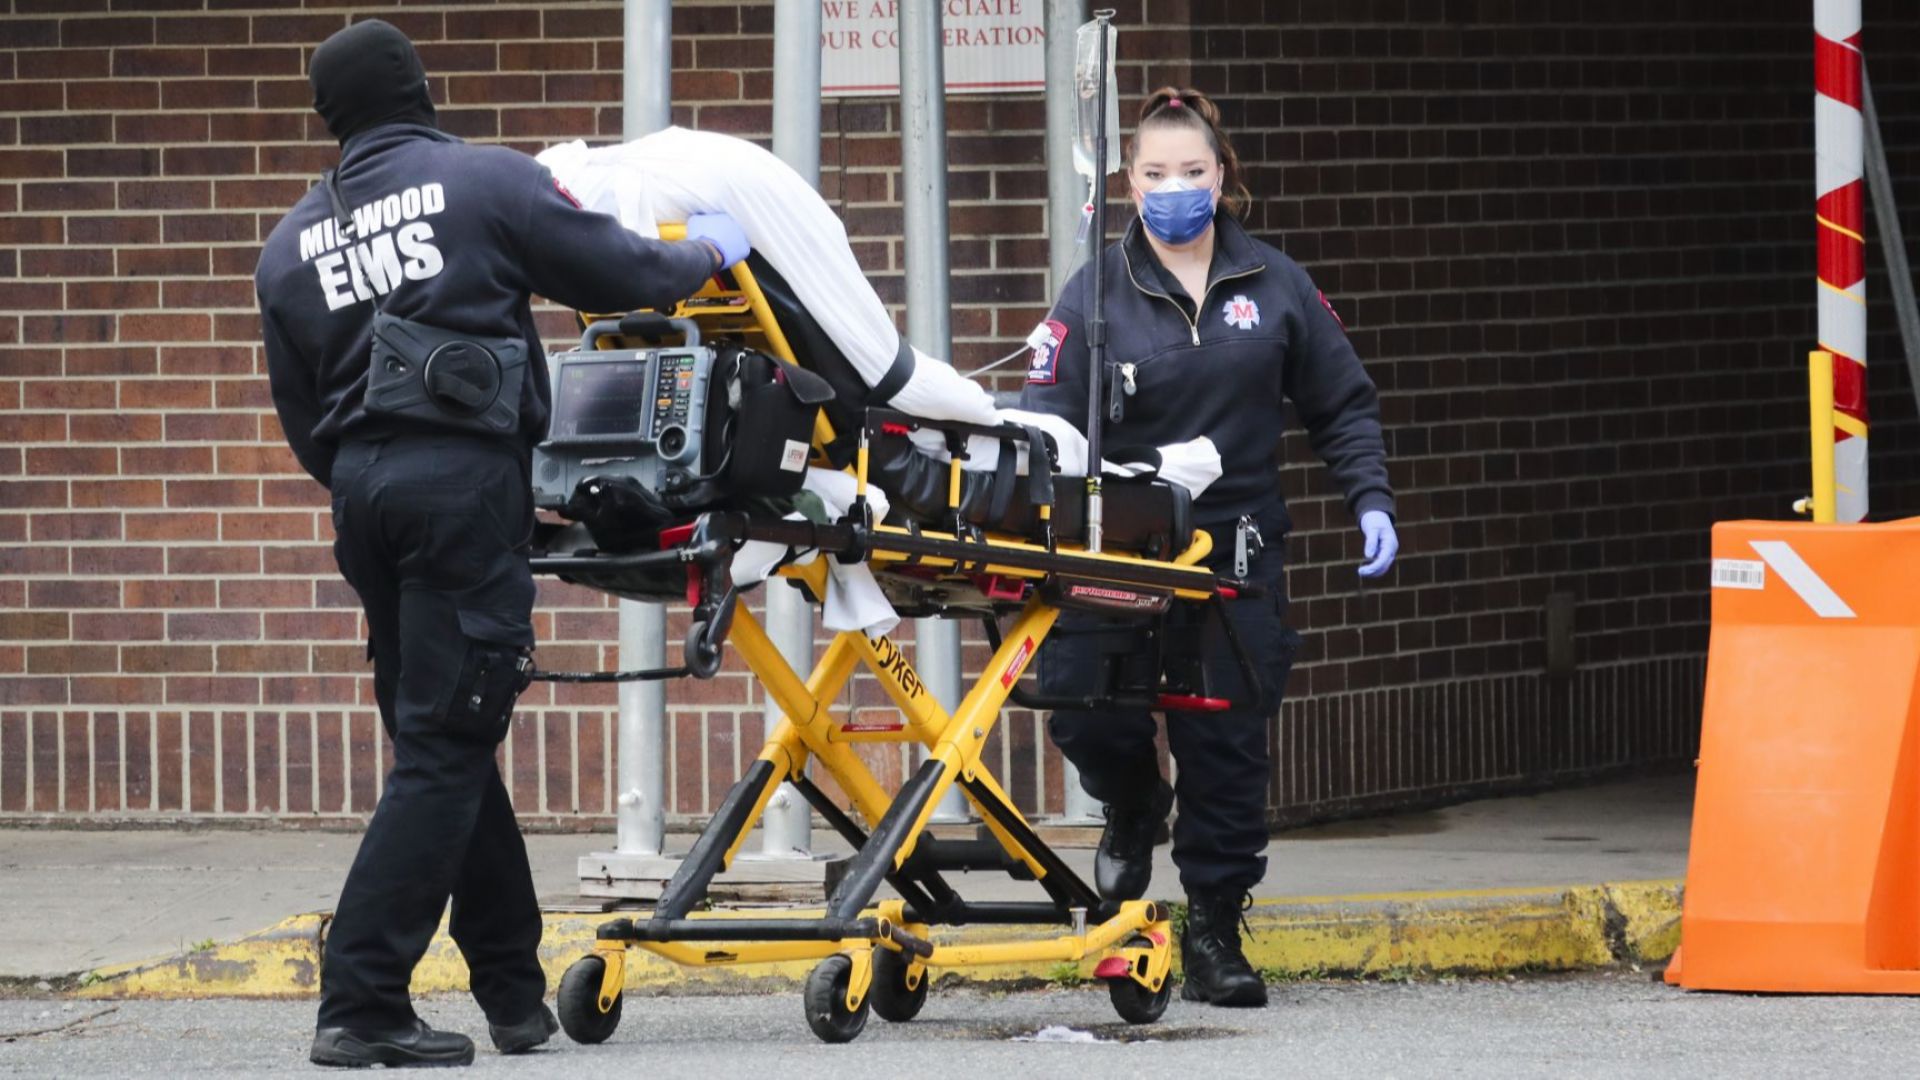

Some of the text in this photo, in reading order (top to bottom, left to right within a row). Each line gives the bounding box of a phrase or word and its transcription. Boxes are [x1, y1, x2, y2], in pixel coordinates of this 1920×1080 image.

[823, 0, 1022, 19] WE APCIATE
[871, 26, 1046, 49] COERATION
[315, 221, 444, 312] EMS
[1232, 303, 1254, 319] M
[861, 628, 924, 699] ryker
